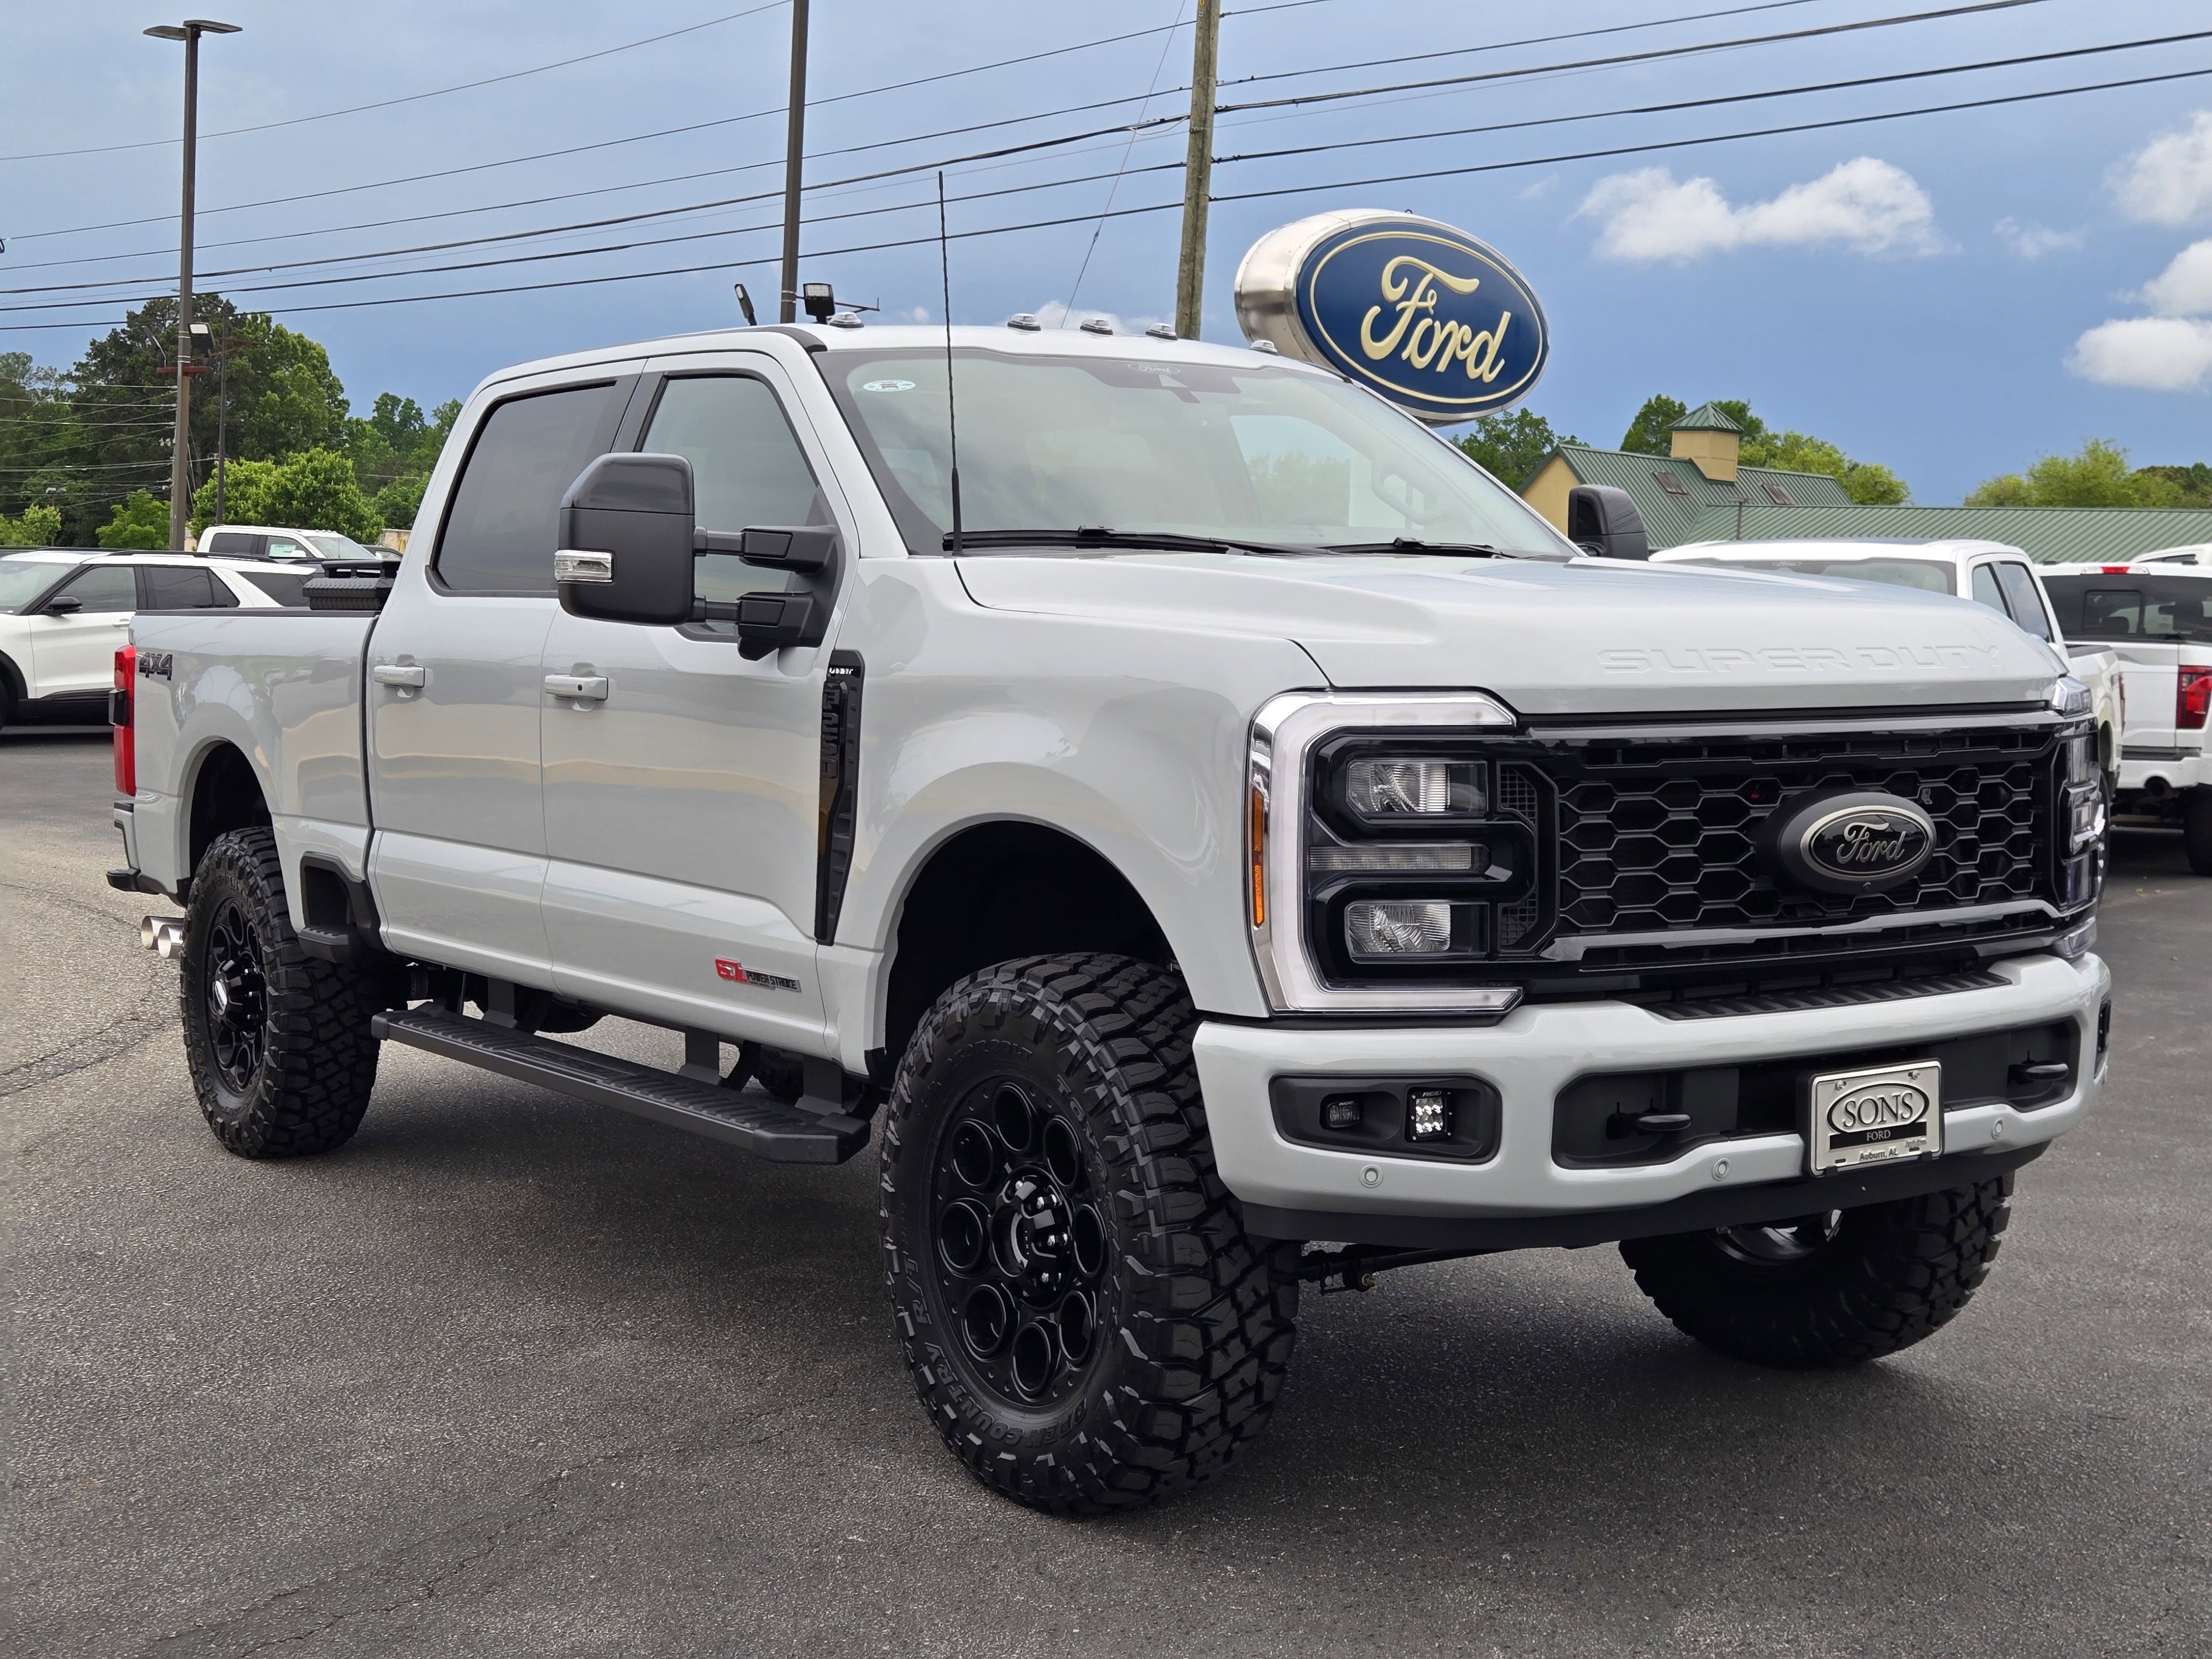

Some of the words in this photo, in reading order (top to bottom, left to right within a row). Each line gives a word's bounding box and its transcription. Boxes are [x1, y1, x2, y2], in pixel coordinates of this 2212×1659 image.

[1361, 256, 1511, 383] Ford
[1596, 646, 1852, 673] SUPER
[1855, 645, 2000, 671] DUTY
[1837, 822, 1907, 864] Ford
[747, 971, 770, 984] POWER
[769, 975, 797, 990] STROKE
[1057, 1074, 1108, 1177] TOYO
[1842, 1091, 1913, 1129] SONS
[1859, 1150, 1887, 1161] Auburn,
[1888, 1147, 1898, 1156] AL
[1866, 1130, 1891, 1141] FORD
[904, 1258, 932, 1325] R/T
[924, 1342, 1023, 1446] COUNTRY
[1024, 1397, 1087, 1448] OPEN
